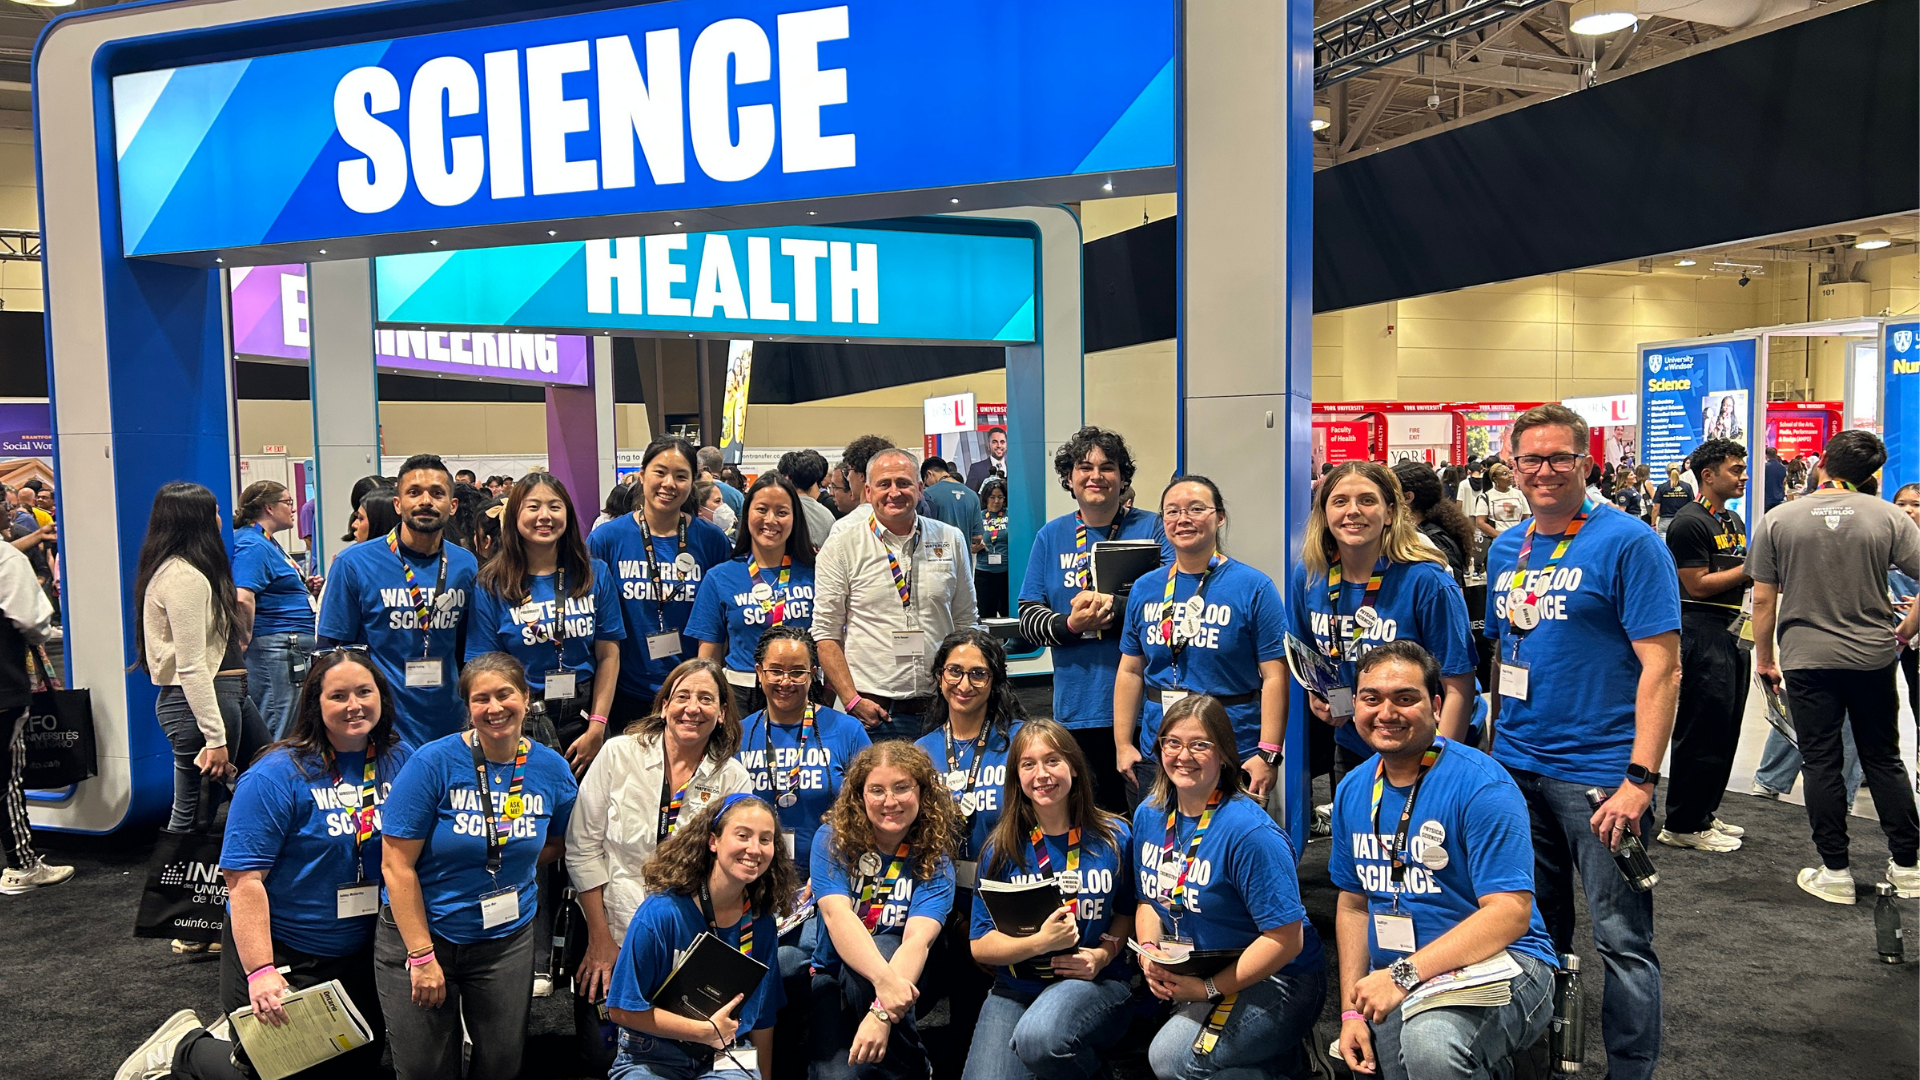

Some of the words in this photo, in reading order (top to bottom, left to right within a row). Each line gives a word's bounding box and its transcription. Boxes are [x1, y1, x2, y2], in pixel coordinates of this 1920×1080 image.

[334, 5, 856, 214] SCIENCE
[585, 233, 879, 324] HEALTH
[281, 273, 558, 374] EINEERING
[1664, 355, 1694, 364] University
[1669, 362, 1694, 370] Windsor
[1648, 378, 1691, 392] Science
[1331, 426, 1352, 434] Faculty
[2, 441, 31, 450] Social
[32, 441, 53, 450] Wor
[1356, 614, 1374, 628] SCIENCES
[1359, 608, 1377, 621] PHYSICAL
[1522, 607, 1532, 626] BIOLOGY
[1421, 832, 1443, 843] SCIENCES
[1423, 825, 1444, 837] PHYSICAL
[194, 884, 229, 897] UNIVE
[192, 894, 207, 904] de
[174, 917, 223, 930] ouinfo.ca
[323, 990, 338, 1012] Ontario
